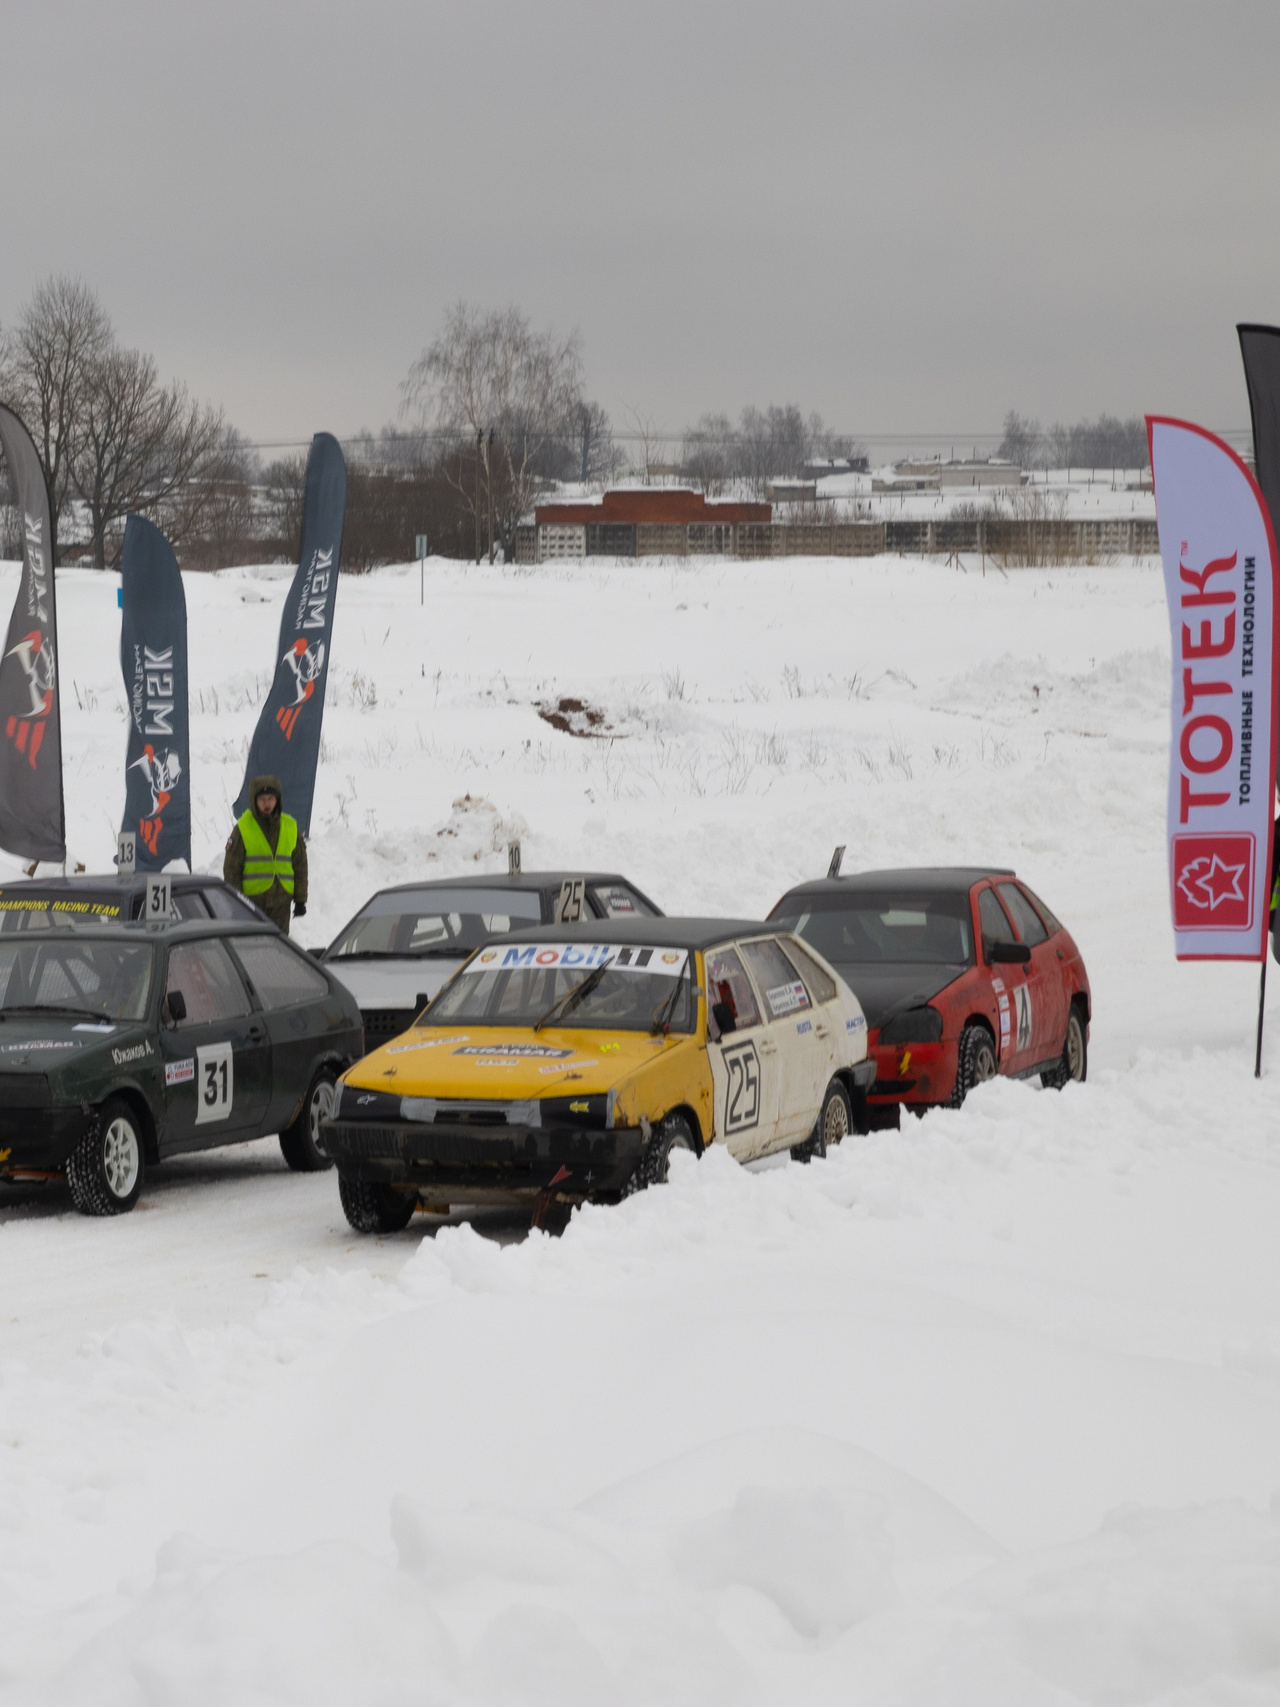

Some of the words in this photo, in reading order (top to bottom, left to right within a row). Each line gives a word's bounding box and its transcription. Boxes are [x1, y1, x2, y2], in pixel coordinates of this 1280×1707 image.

[1242, 556, 1256, 678] ТЕХНОЛОГИИ
[1239, 690, 1253, 806] ТОПЛИВНЫЕ
[120, 842, 134, 863] 13
[51, 900, 89, 914] RACING
[91, 903, 120, 917] TEAM
[151, 885, 167, 913] 31
[561, 881, 582, 922] 25
[501, 945, 610, 967] Mobil
[204, 1059, 228, 1107] 31
[728, 1052, 758, 1125] 25
